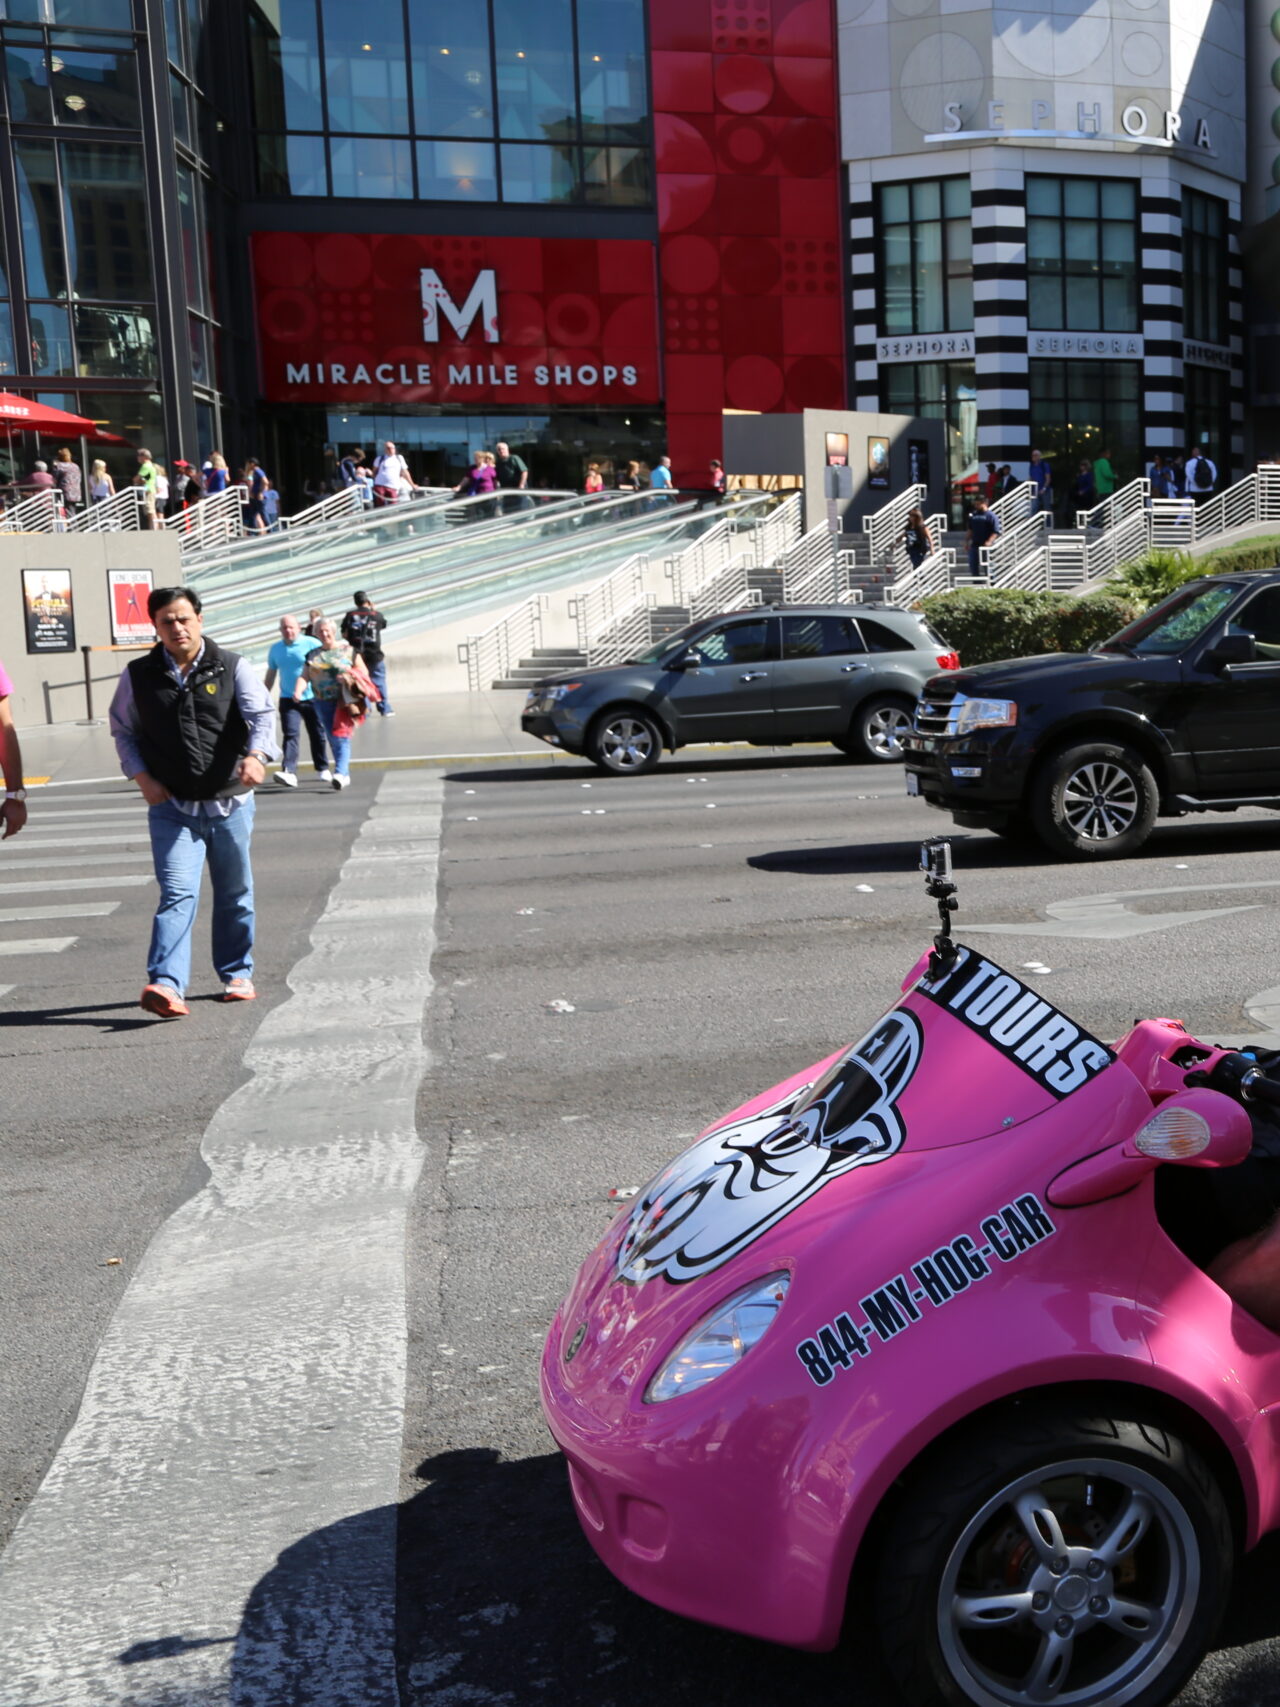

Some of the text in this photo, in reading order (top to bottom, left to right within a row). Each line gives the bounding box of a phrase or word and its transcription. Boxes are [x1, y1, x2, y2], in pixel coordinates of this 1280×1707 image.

[943, 99, 1213, 151] SEPHORA
[420, 267, 500, 344] M
[879, 336, 971, 359] SEPHORA
[1035, 337, 1138, 354] SEPHORA
[286, 362, 638, 387] MIRACLE MILE SHOPS
[948, 959, 1111, 1094] TOURS
[796, 1193, 1057, 1387] 844-MY-HOG-CAR
